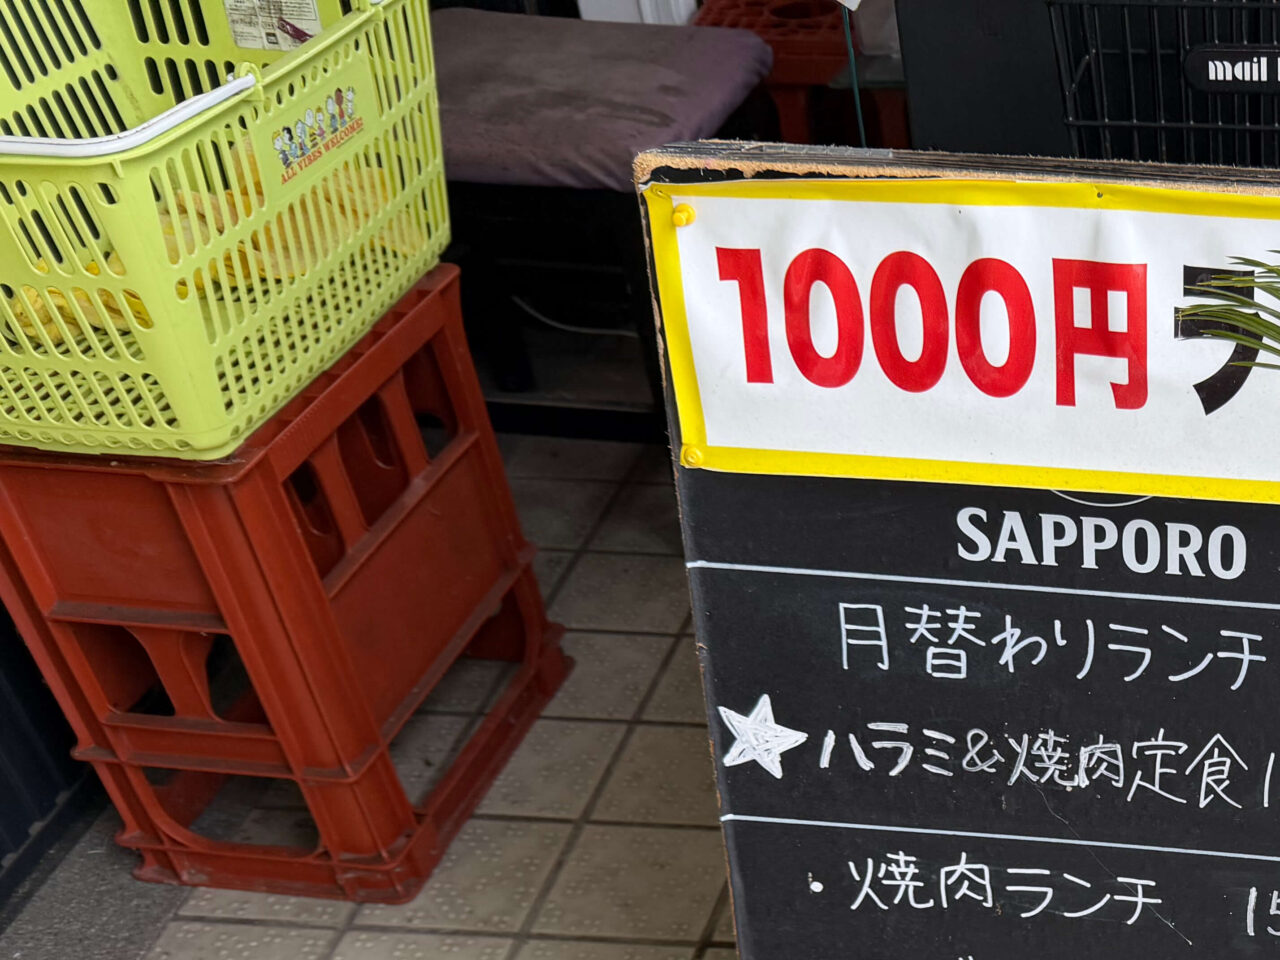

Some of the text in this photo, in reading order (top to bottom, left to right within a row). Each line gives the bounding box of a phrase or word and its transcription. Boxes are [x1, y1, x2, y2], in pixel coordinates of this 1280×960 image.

[1208, 56, 1268, 83] mail
[715, 247, 1148, 410] 1000円
[956, 507, 1248, 580] SAPPORO
[838, 602, 1267, 691] 月替わりランチ
[848, 851, 1163, 925] 焼肉ランチ
